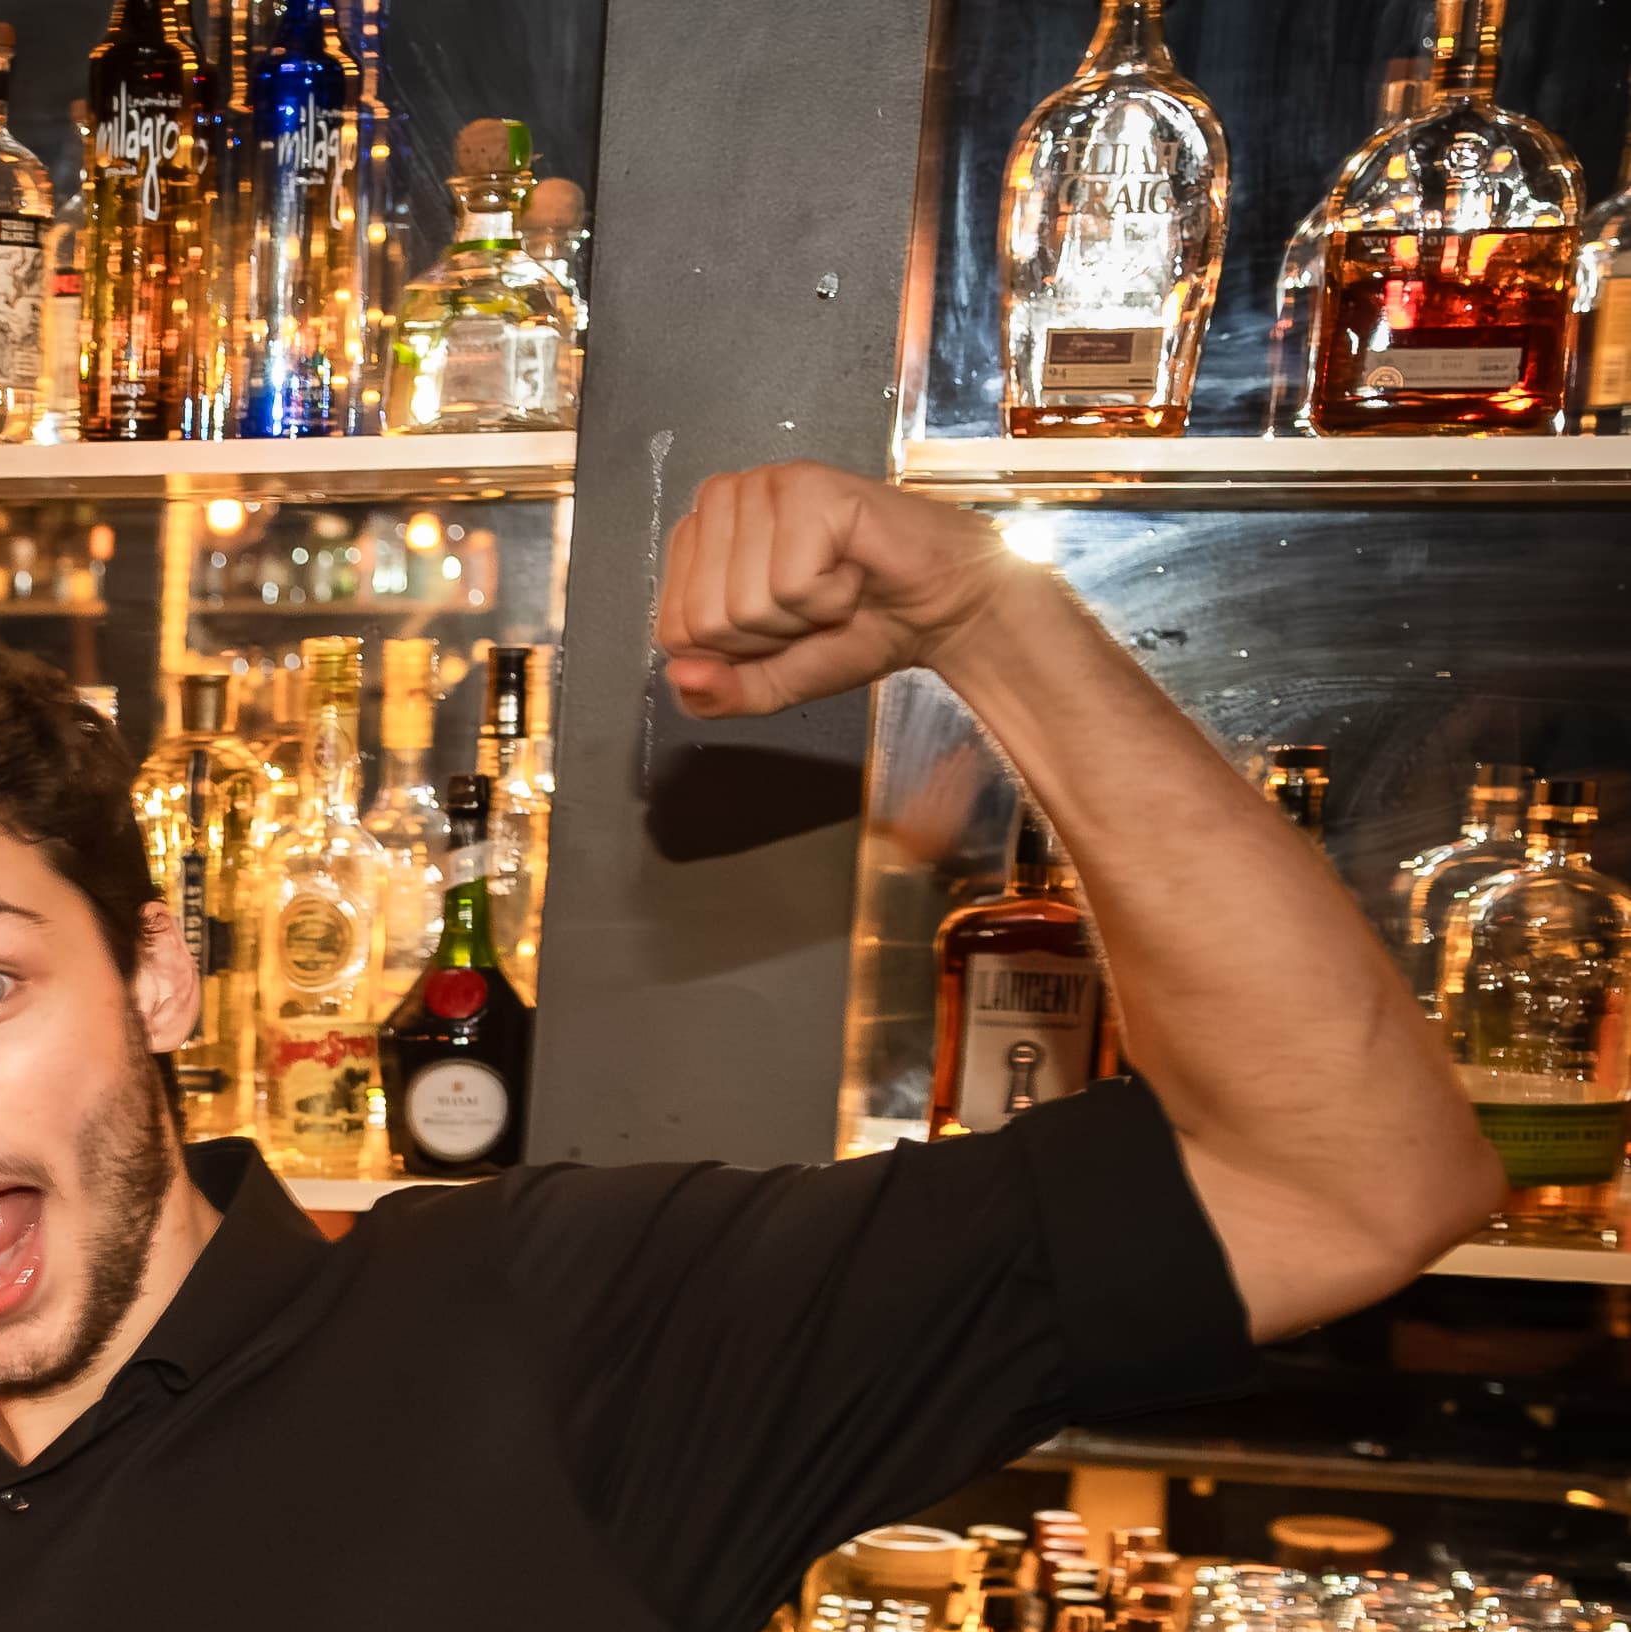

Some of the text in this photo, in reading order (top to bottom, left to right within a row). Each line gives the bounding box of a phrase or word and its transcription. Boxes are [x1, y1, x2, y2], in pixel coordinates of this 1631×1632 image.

[96, 80, 181, 222] milagro
[1060, 136, 1179, 178] ELIJAH
[1057, 176, 1176, 219] CRAIG
